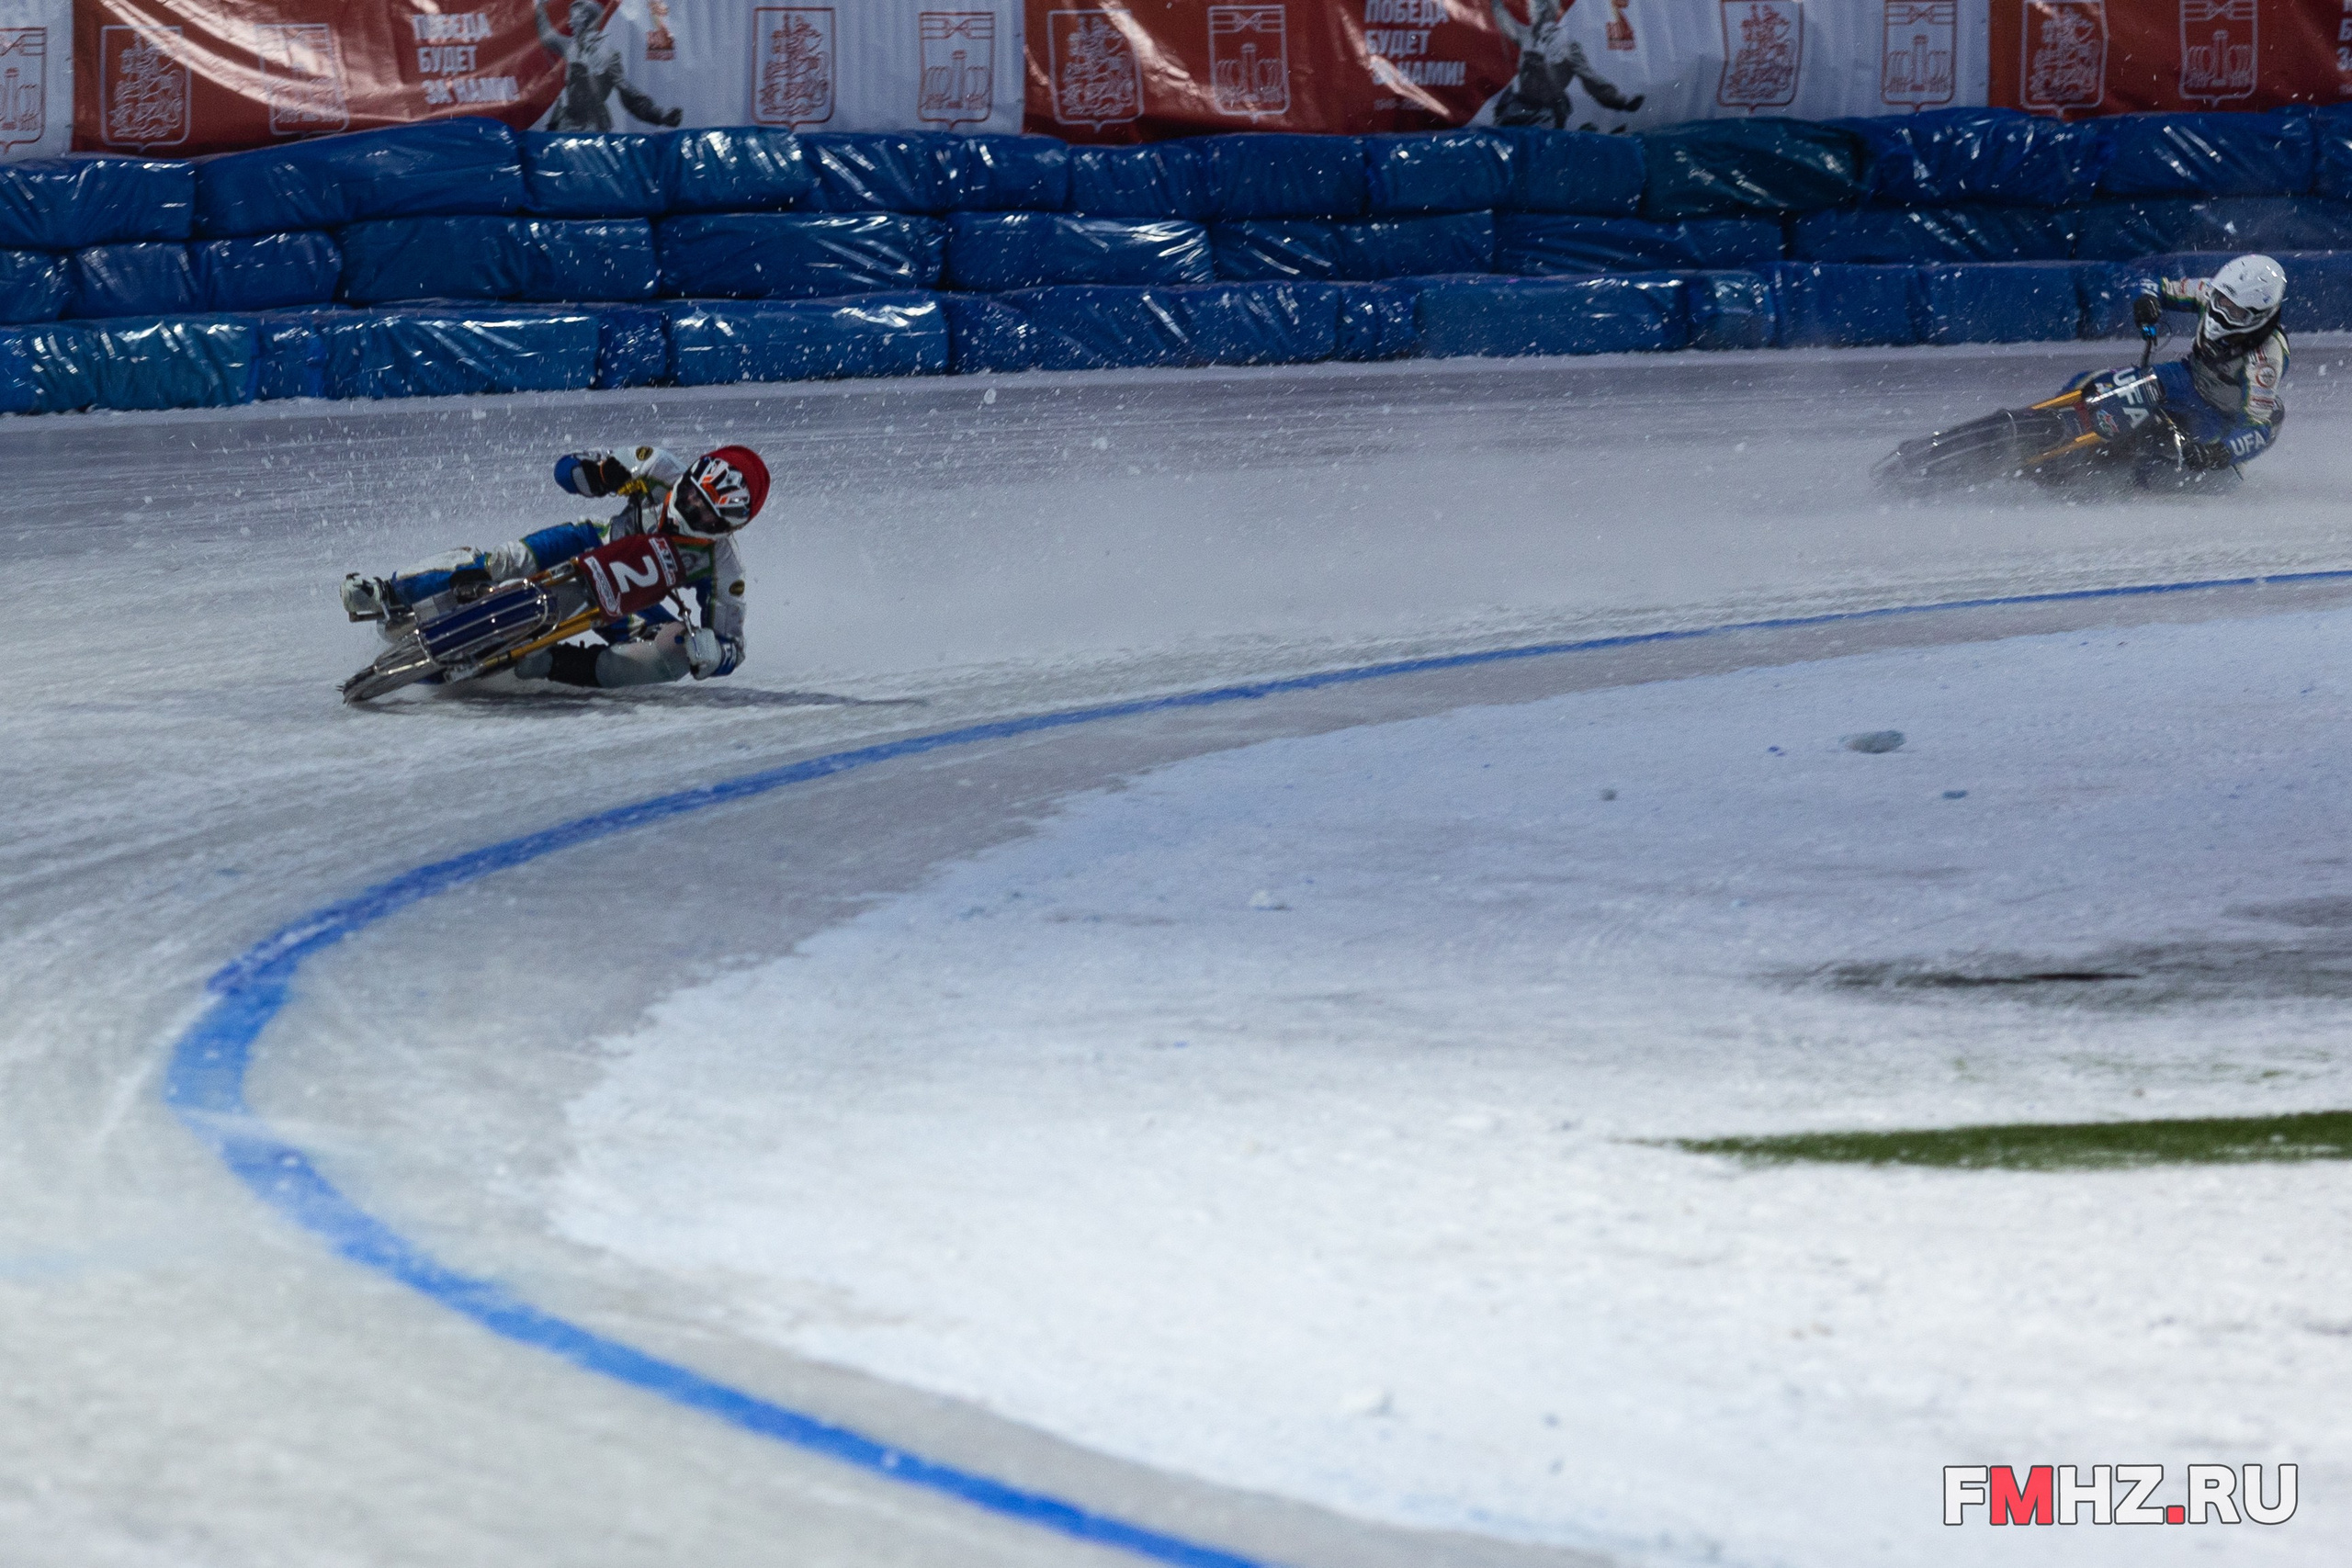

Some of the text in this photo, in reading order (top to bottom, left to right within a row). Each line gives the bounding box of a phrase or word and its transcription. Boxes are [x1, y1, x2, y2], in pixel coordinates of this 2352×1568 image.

[1363, 0, 1449, 27] ПОБЕДА
[413, 12, 492, 45] ПБЕДА
[1364, 29, 1431, 58] БУДЕТ
[417, 45, 477, 75] БУДЕТ
[2230, 430, 2267, 457] UFA
[608, 555, 660, 594] 2
